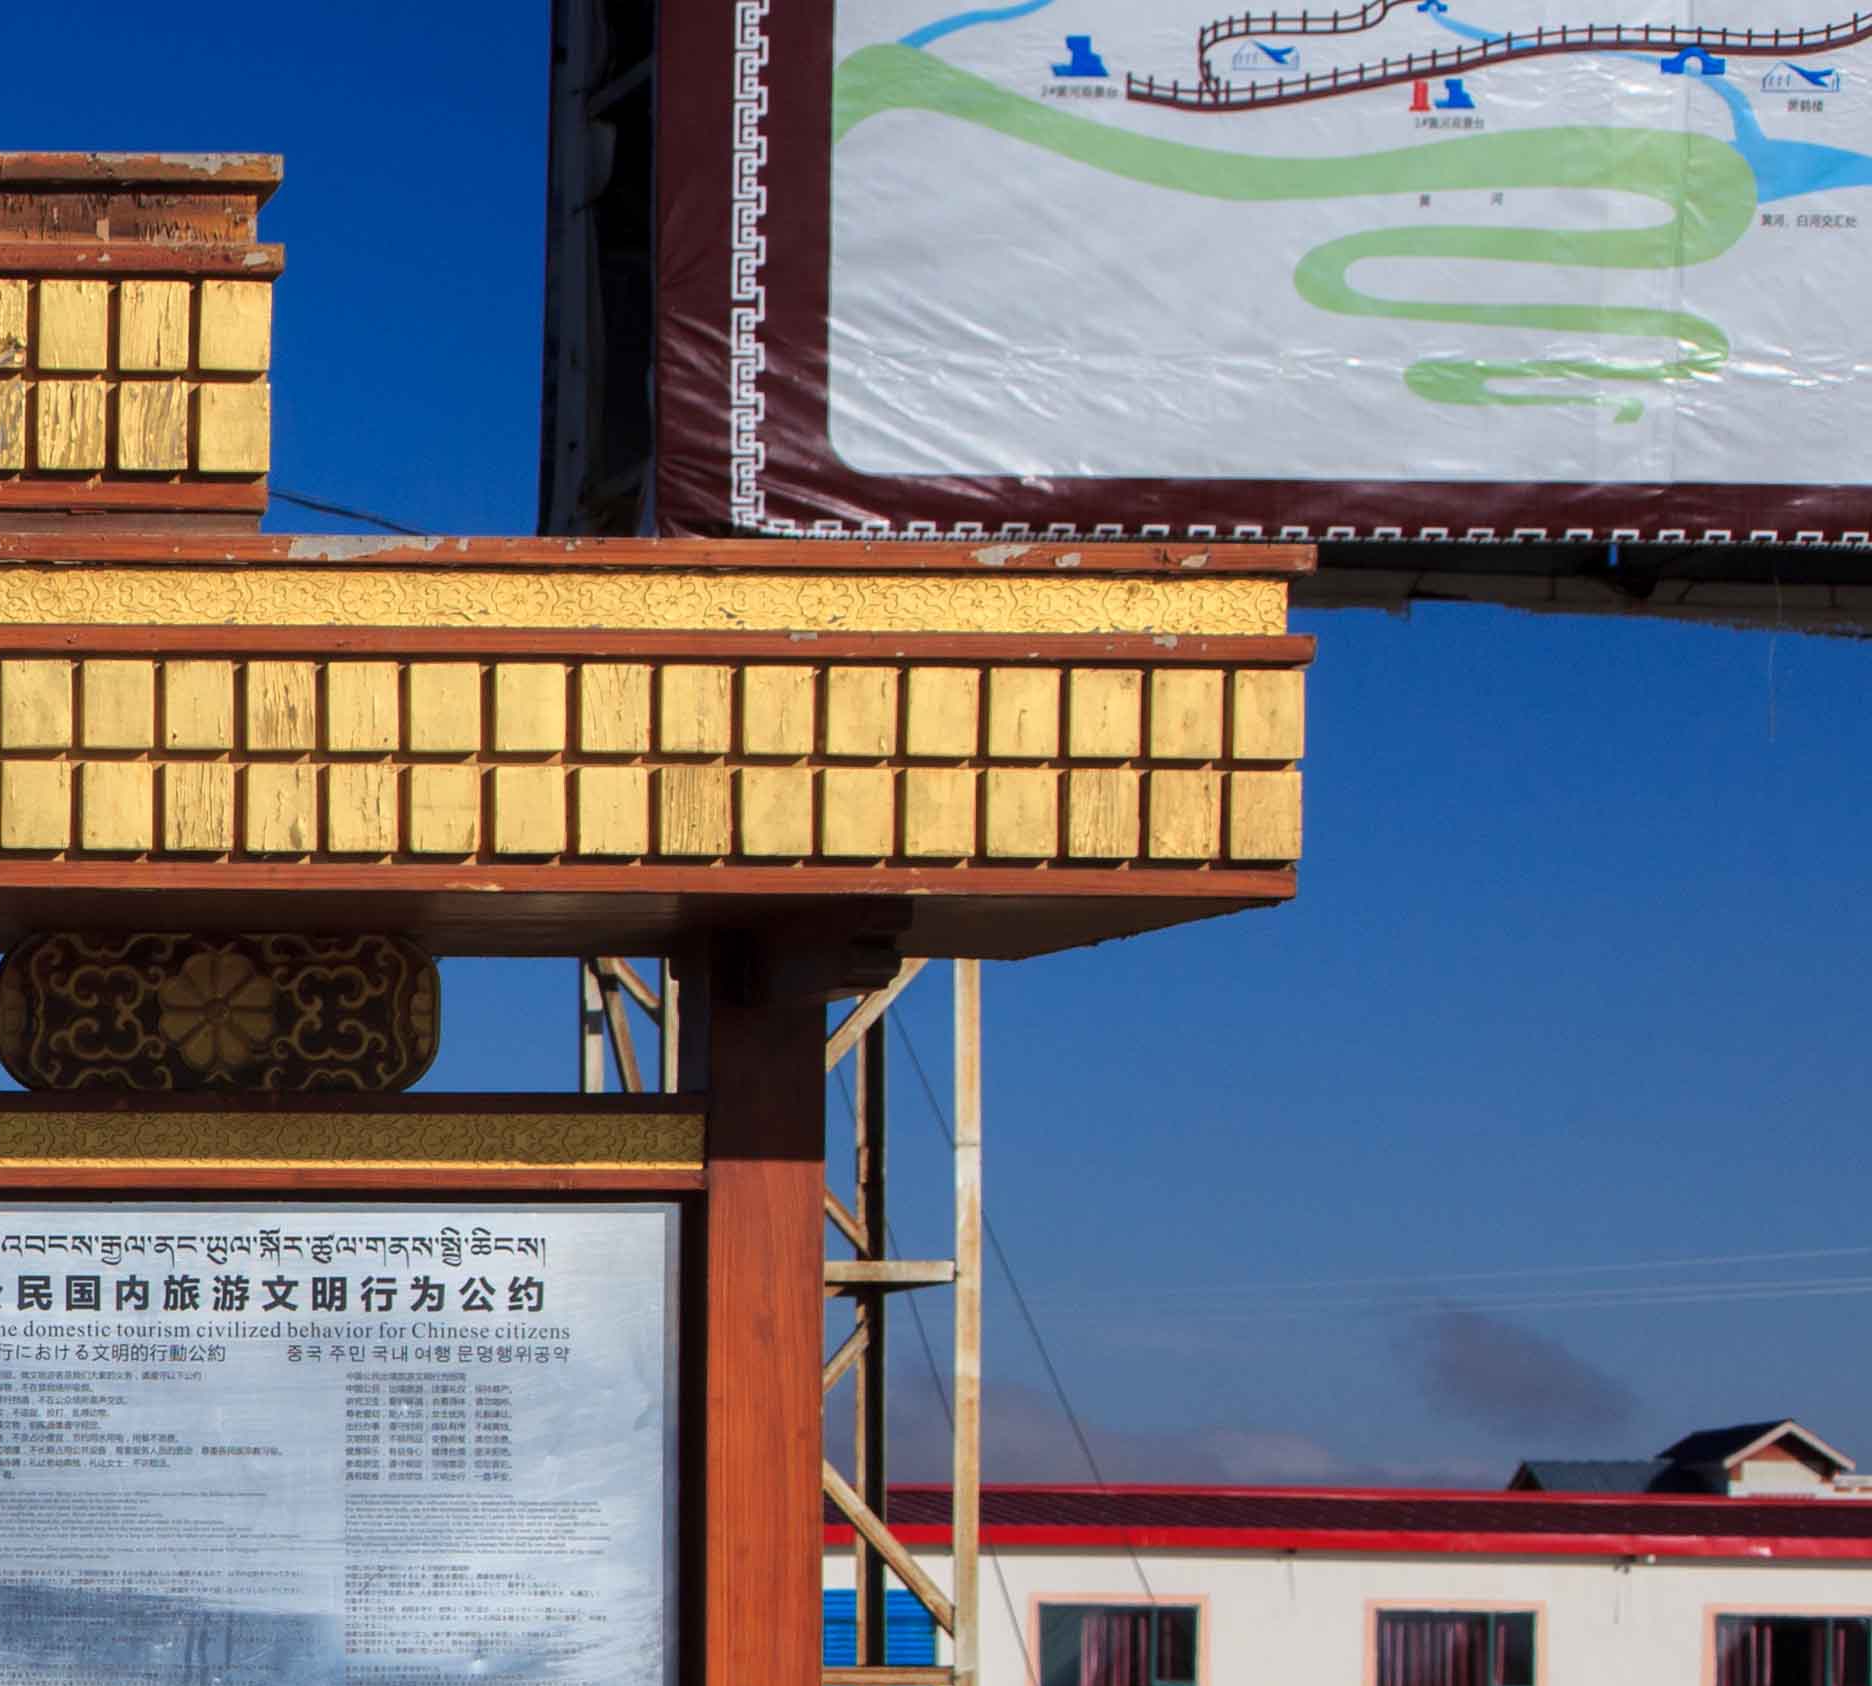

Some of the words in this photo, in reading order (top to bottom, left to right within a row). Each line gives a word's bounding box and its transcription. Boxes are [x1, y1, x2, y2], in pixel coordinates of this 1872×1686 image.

[24, 1320, 112, 1338] domestic
[117, 1321, 191, 1338] tourism
[196, 1321, 281, 1339] civilized
[287, 1321, 374, 1339] behavior
[379, 1322, 407, 1339] for
[412, 1322, 490, 1340] Chinese
[495, 1323, 570, 1340] citizens
[287, 1345, 323, 1363] 중국
[328, 1344, 365, 1363] 주민
[371, 1345, 408, 1363] 국내
[415, 1345, 451, 1363] 여행
[458, 1345, 571, 1364] 문명행위공약
